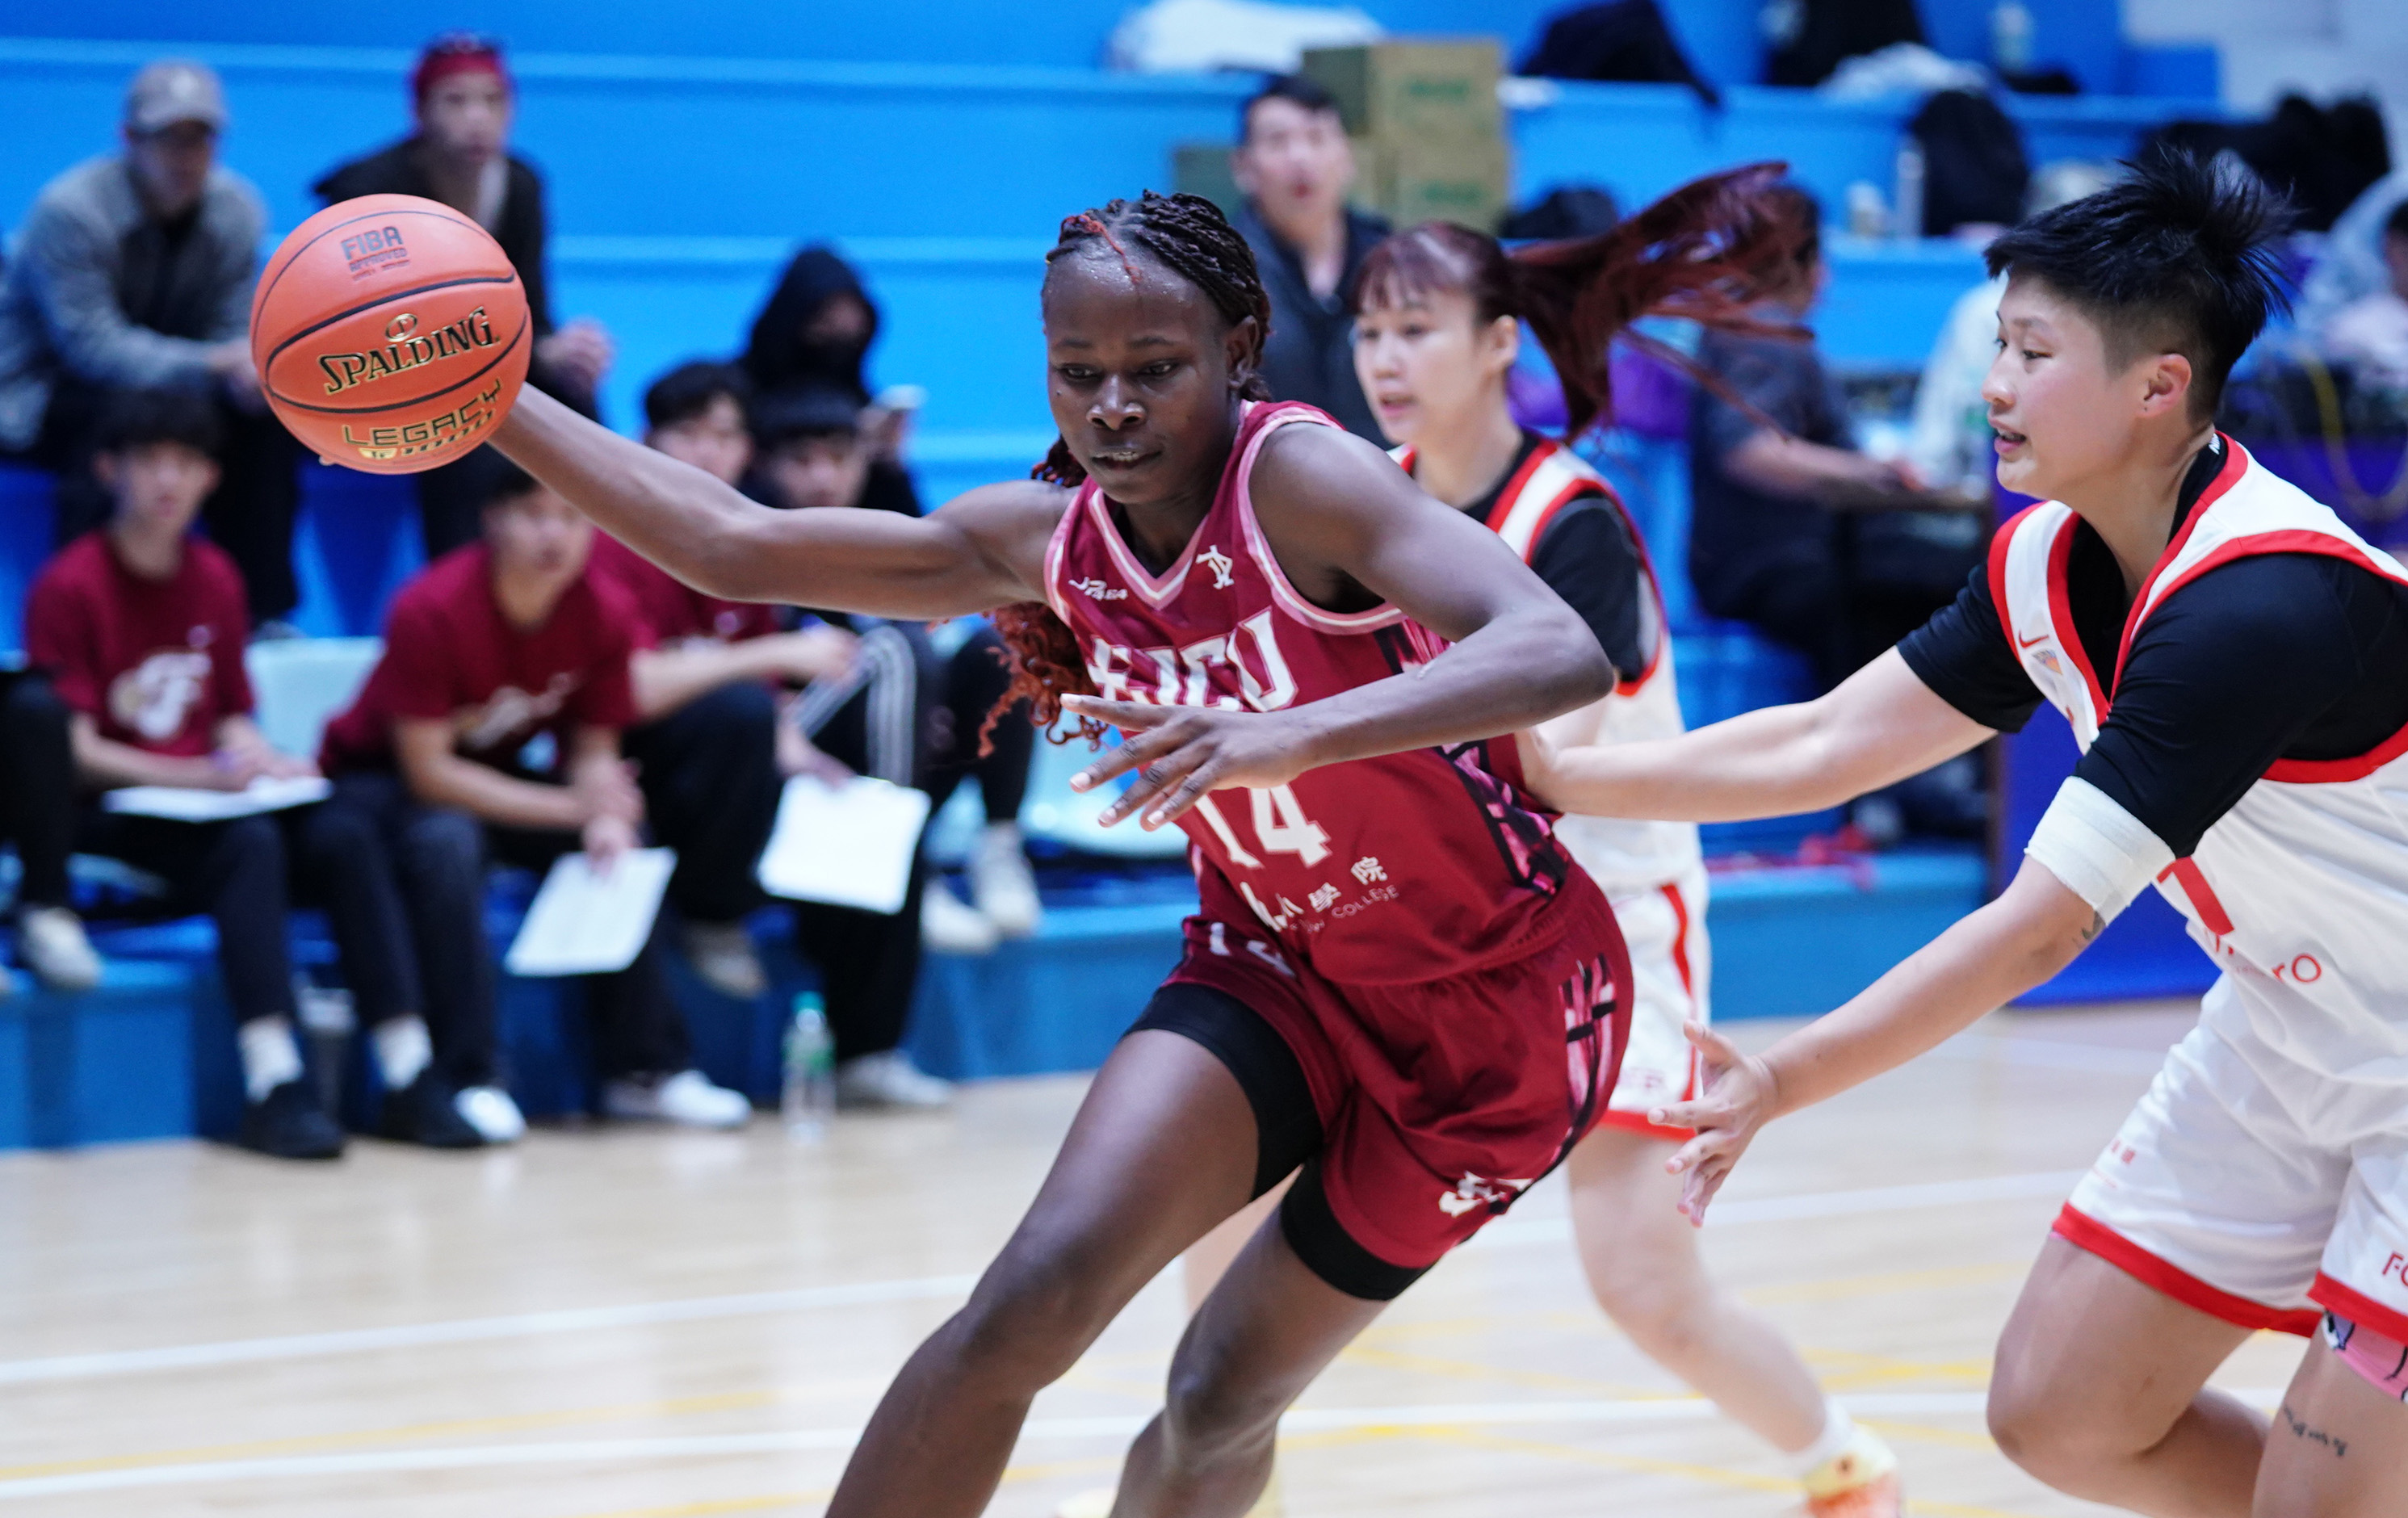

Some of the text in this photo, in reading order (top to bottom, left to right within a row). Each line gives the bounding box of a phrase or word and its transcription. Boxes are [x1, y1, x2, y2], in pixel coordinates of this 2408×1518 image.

[341, 226, 404, 261] FIBA
[318, 306, 497, 396] SPALDING
[342, 378, 502, 447] LEGACY
[1332, 885, 1399, 918] COLLEGE
